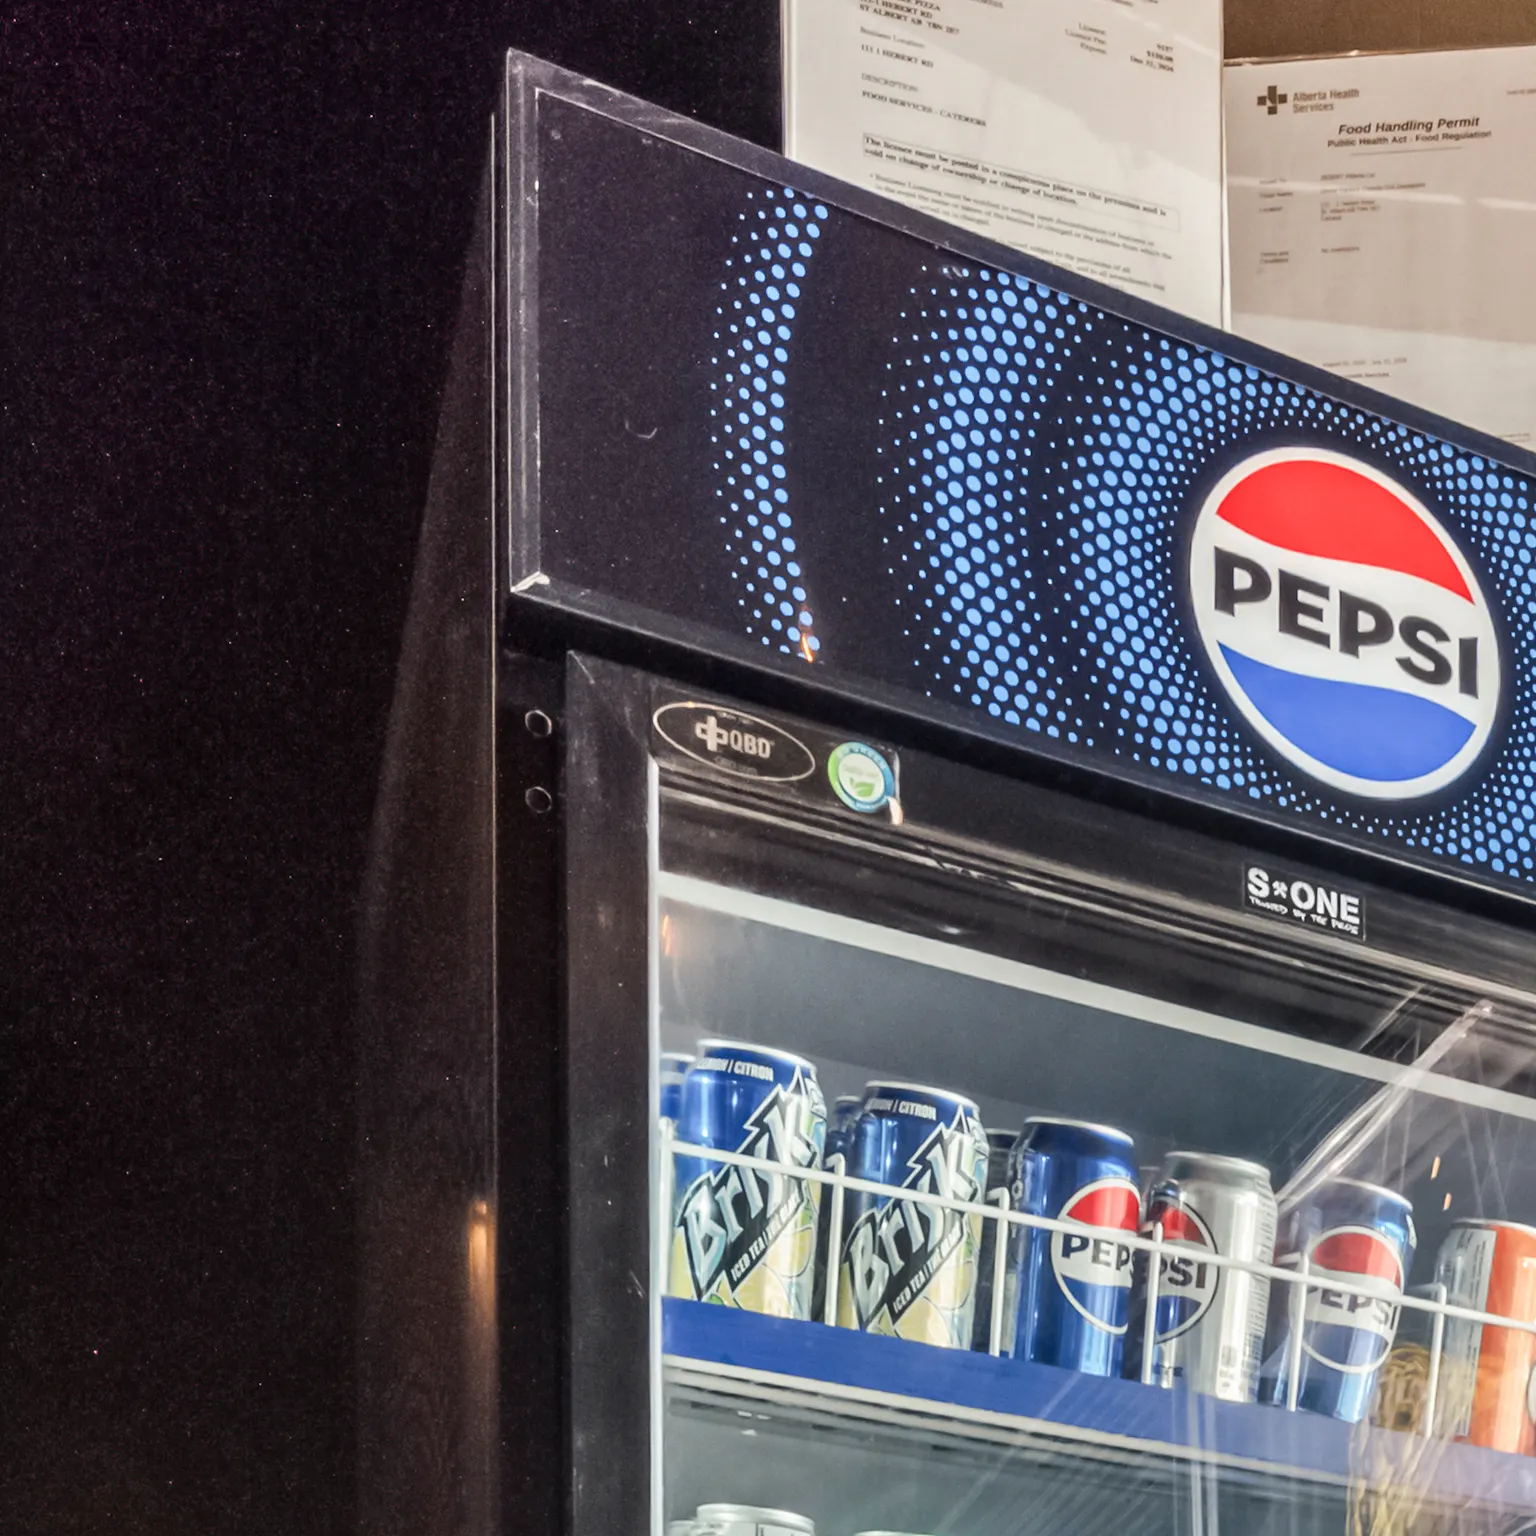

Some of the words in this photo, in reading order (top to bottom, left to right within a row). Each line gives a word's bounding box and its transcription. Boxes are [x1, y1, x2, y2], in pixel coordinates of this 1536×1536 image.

[860, 72, 918, 92] DESCRIPTION
[1292, 91, 1328, 103] Alberta
[1329, 88, 1360, 100] Health
[861, 90, 888, 103] FOOD
[888, 97, 933, 114] SERVICES
[939, 109, 987, 127] CATERERS
[1292, 102, 1334, 113] Services
[1337, 122, 1372, 136] Food
[1375, 119, 1433, 133] Handling
[1437, 116, 1480, 129] Permit
[1326, 138, 1357, 148] Public
[1358, 136, 1389, 146] Health
[1391, 134, 1408, 145] Act
[1415, 132, 1439, 143] Food
[1441, 130, 1492, 141] Regulation
[866, 136, 881, 147] The
[914, 149, 936, 160] must
[951, 158, 979, 172] posted
[998, 169, 1051, 189] conspicuous
[1052, 183, 1074, 195] place
[898, 156, 929, 170] change
[1000, 180, 1031, 196] change
[1213, 545, 1479, 699] PEPSI
[730, 729, 771, 759] QBD
[734, 1060, 774, 1082] CITRON
[899, 1100, 937, 1122] CITRON
[730, 1253, 751, 1282] ICED
